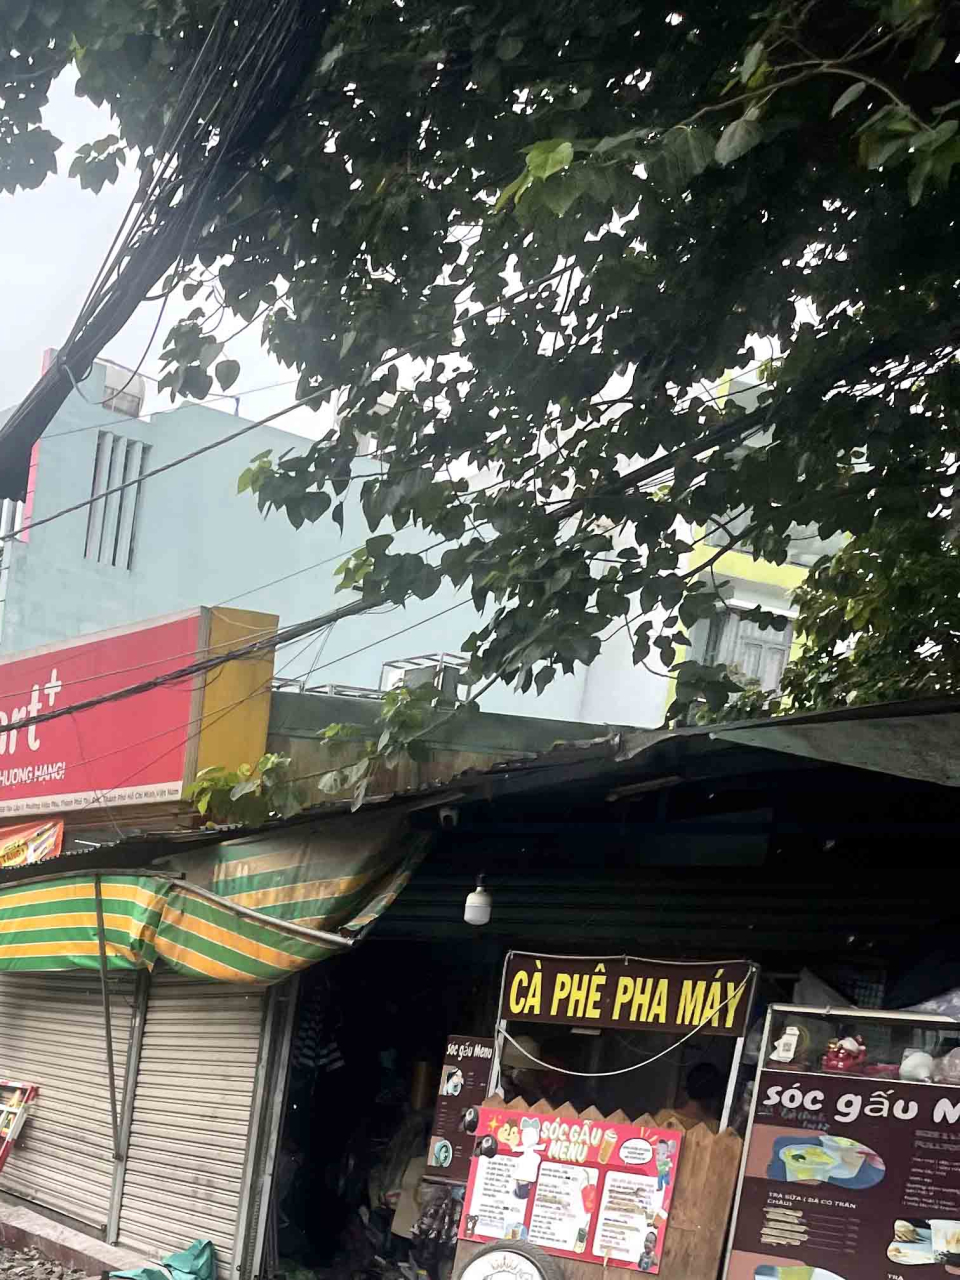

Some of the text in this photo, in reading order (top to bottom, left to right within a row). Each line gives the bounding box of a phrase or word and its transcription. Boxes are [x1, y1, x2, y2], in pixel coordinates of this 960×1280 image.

[509, 960, 747, 1028] CÀ PHÊ PHA MÁY
[763, 1083, 825, 1111] sóc
[834, 1088, 918, 1123] gấu
[541, 1117, 570, 1141] SÓC
[547, 1140, 588, 1164] MENU
